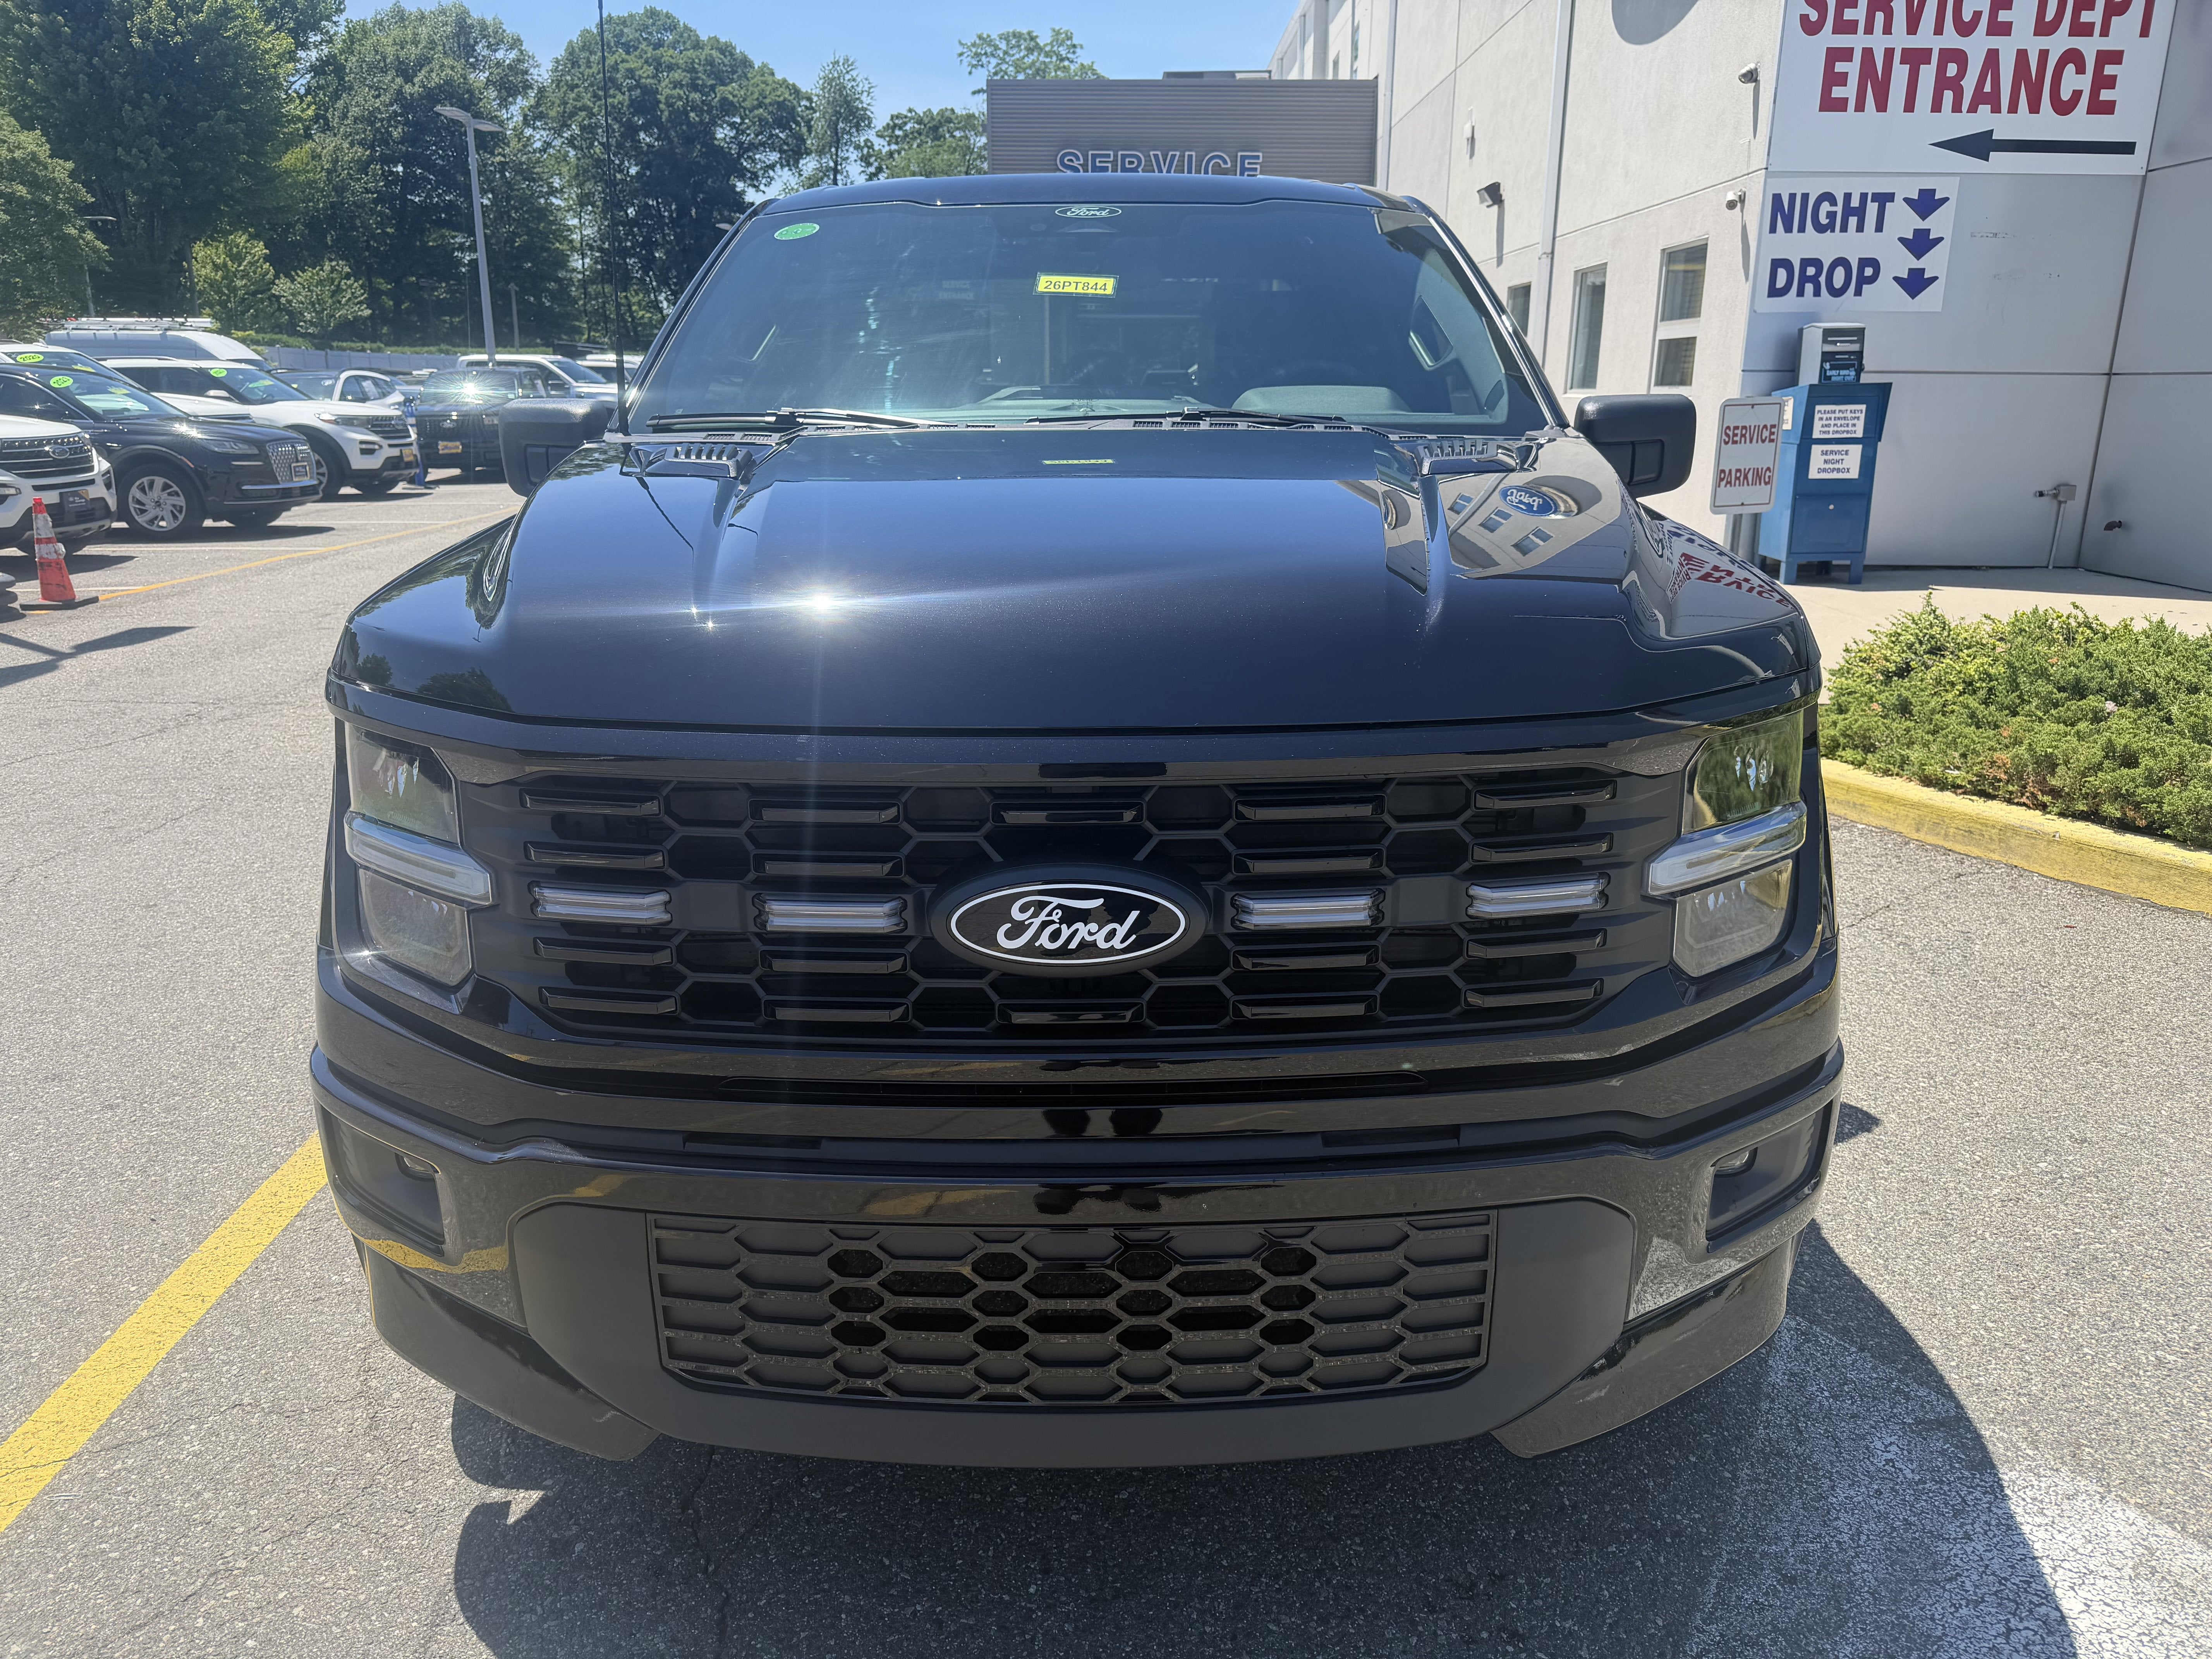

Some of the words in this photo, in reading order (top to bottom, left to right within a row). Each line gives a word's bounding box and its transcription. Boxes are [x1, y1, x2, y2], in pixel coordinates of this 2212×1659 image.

[1799, 0, 2015, 37] SERVICE
[1819, 46, 2125, 116] ENTRANCE
[1056, 149, 1263, 177] SERVICE
[1067, 208, 1109, 216] Ford
[1769, 191, 1896, 234] NIGHT
[1044, 280, 1108, 292] 26PT844
[1767, 256, 1881, 298] DROP
[1723, 424, 1777, 445] SERVICE
[1717, 466, 1772, 488] PARKING
[996, 896, 1140, 950] Ford
